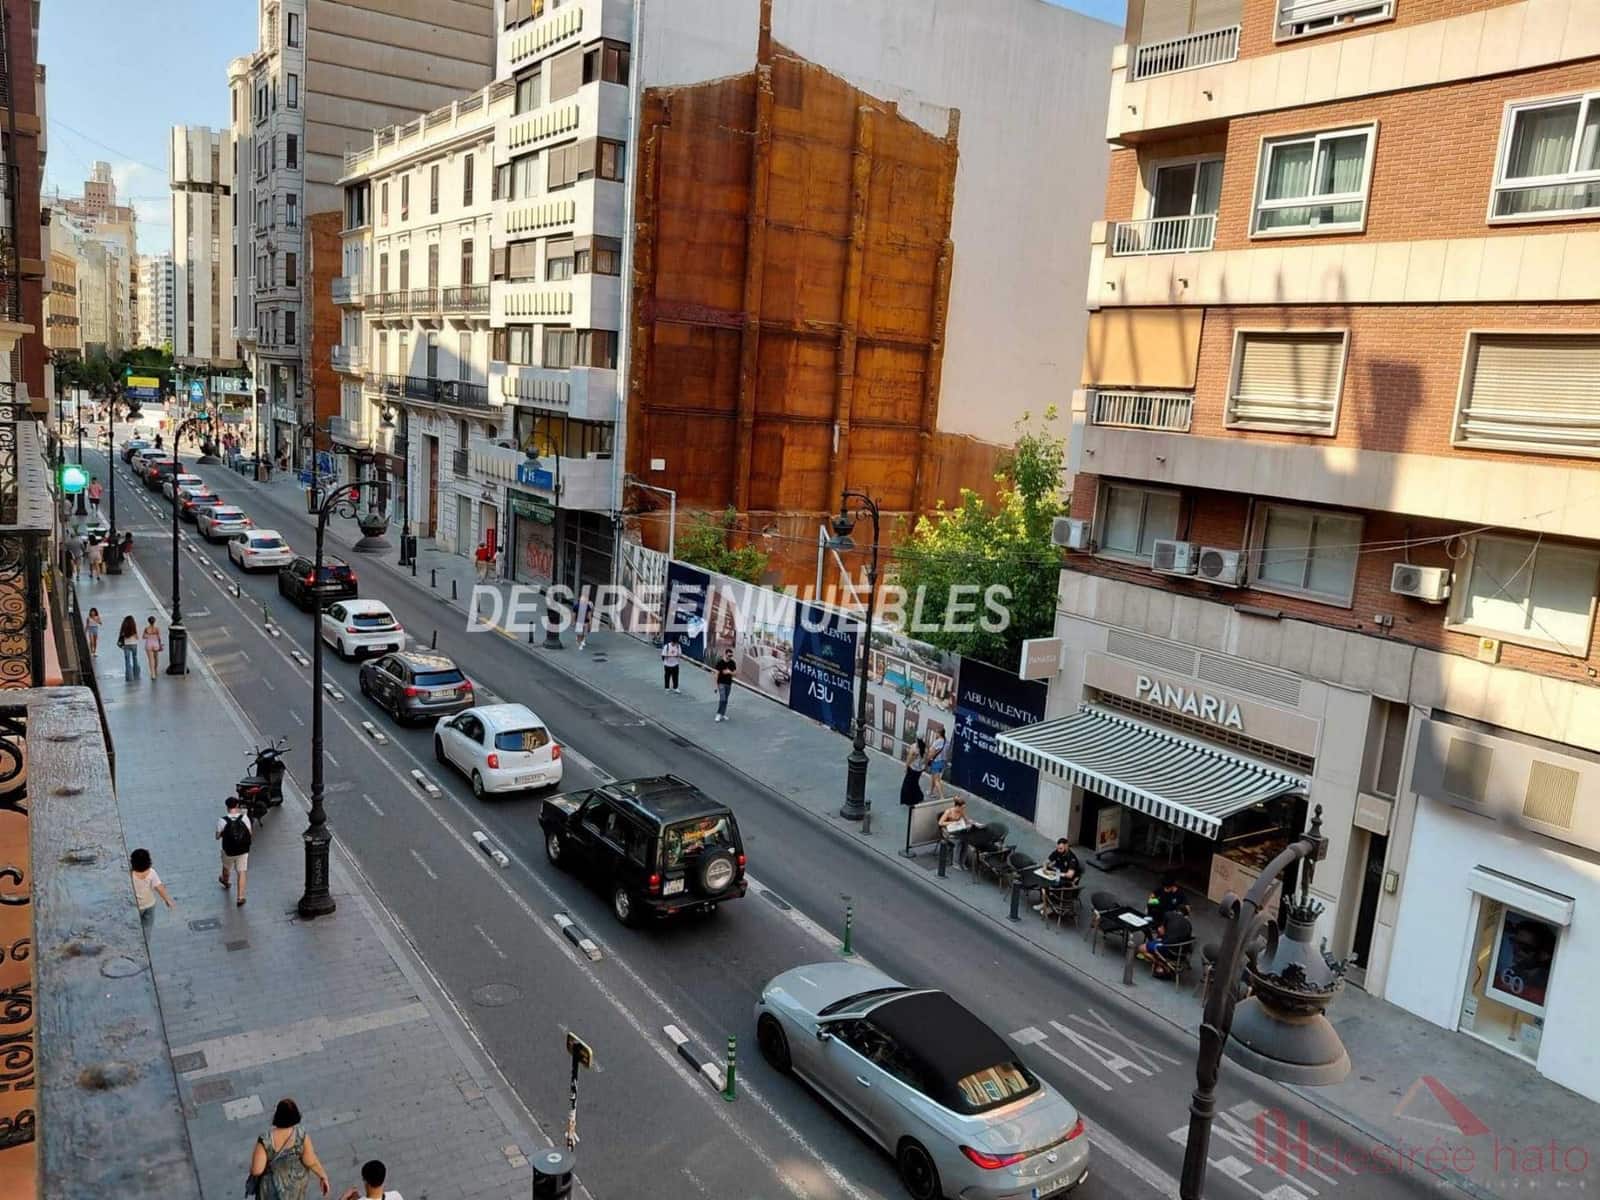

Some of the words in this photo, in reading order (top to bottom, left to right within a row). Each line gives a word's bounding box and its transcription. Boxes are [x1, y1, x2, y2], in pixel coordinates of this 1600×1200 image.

[964, 691, 987, 706] ABU
[987, 699, 1038, 723] VALENTIA
[1135, 675, 1243, 730] PANARIA
